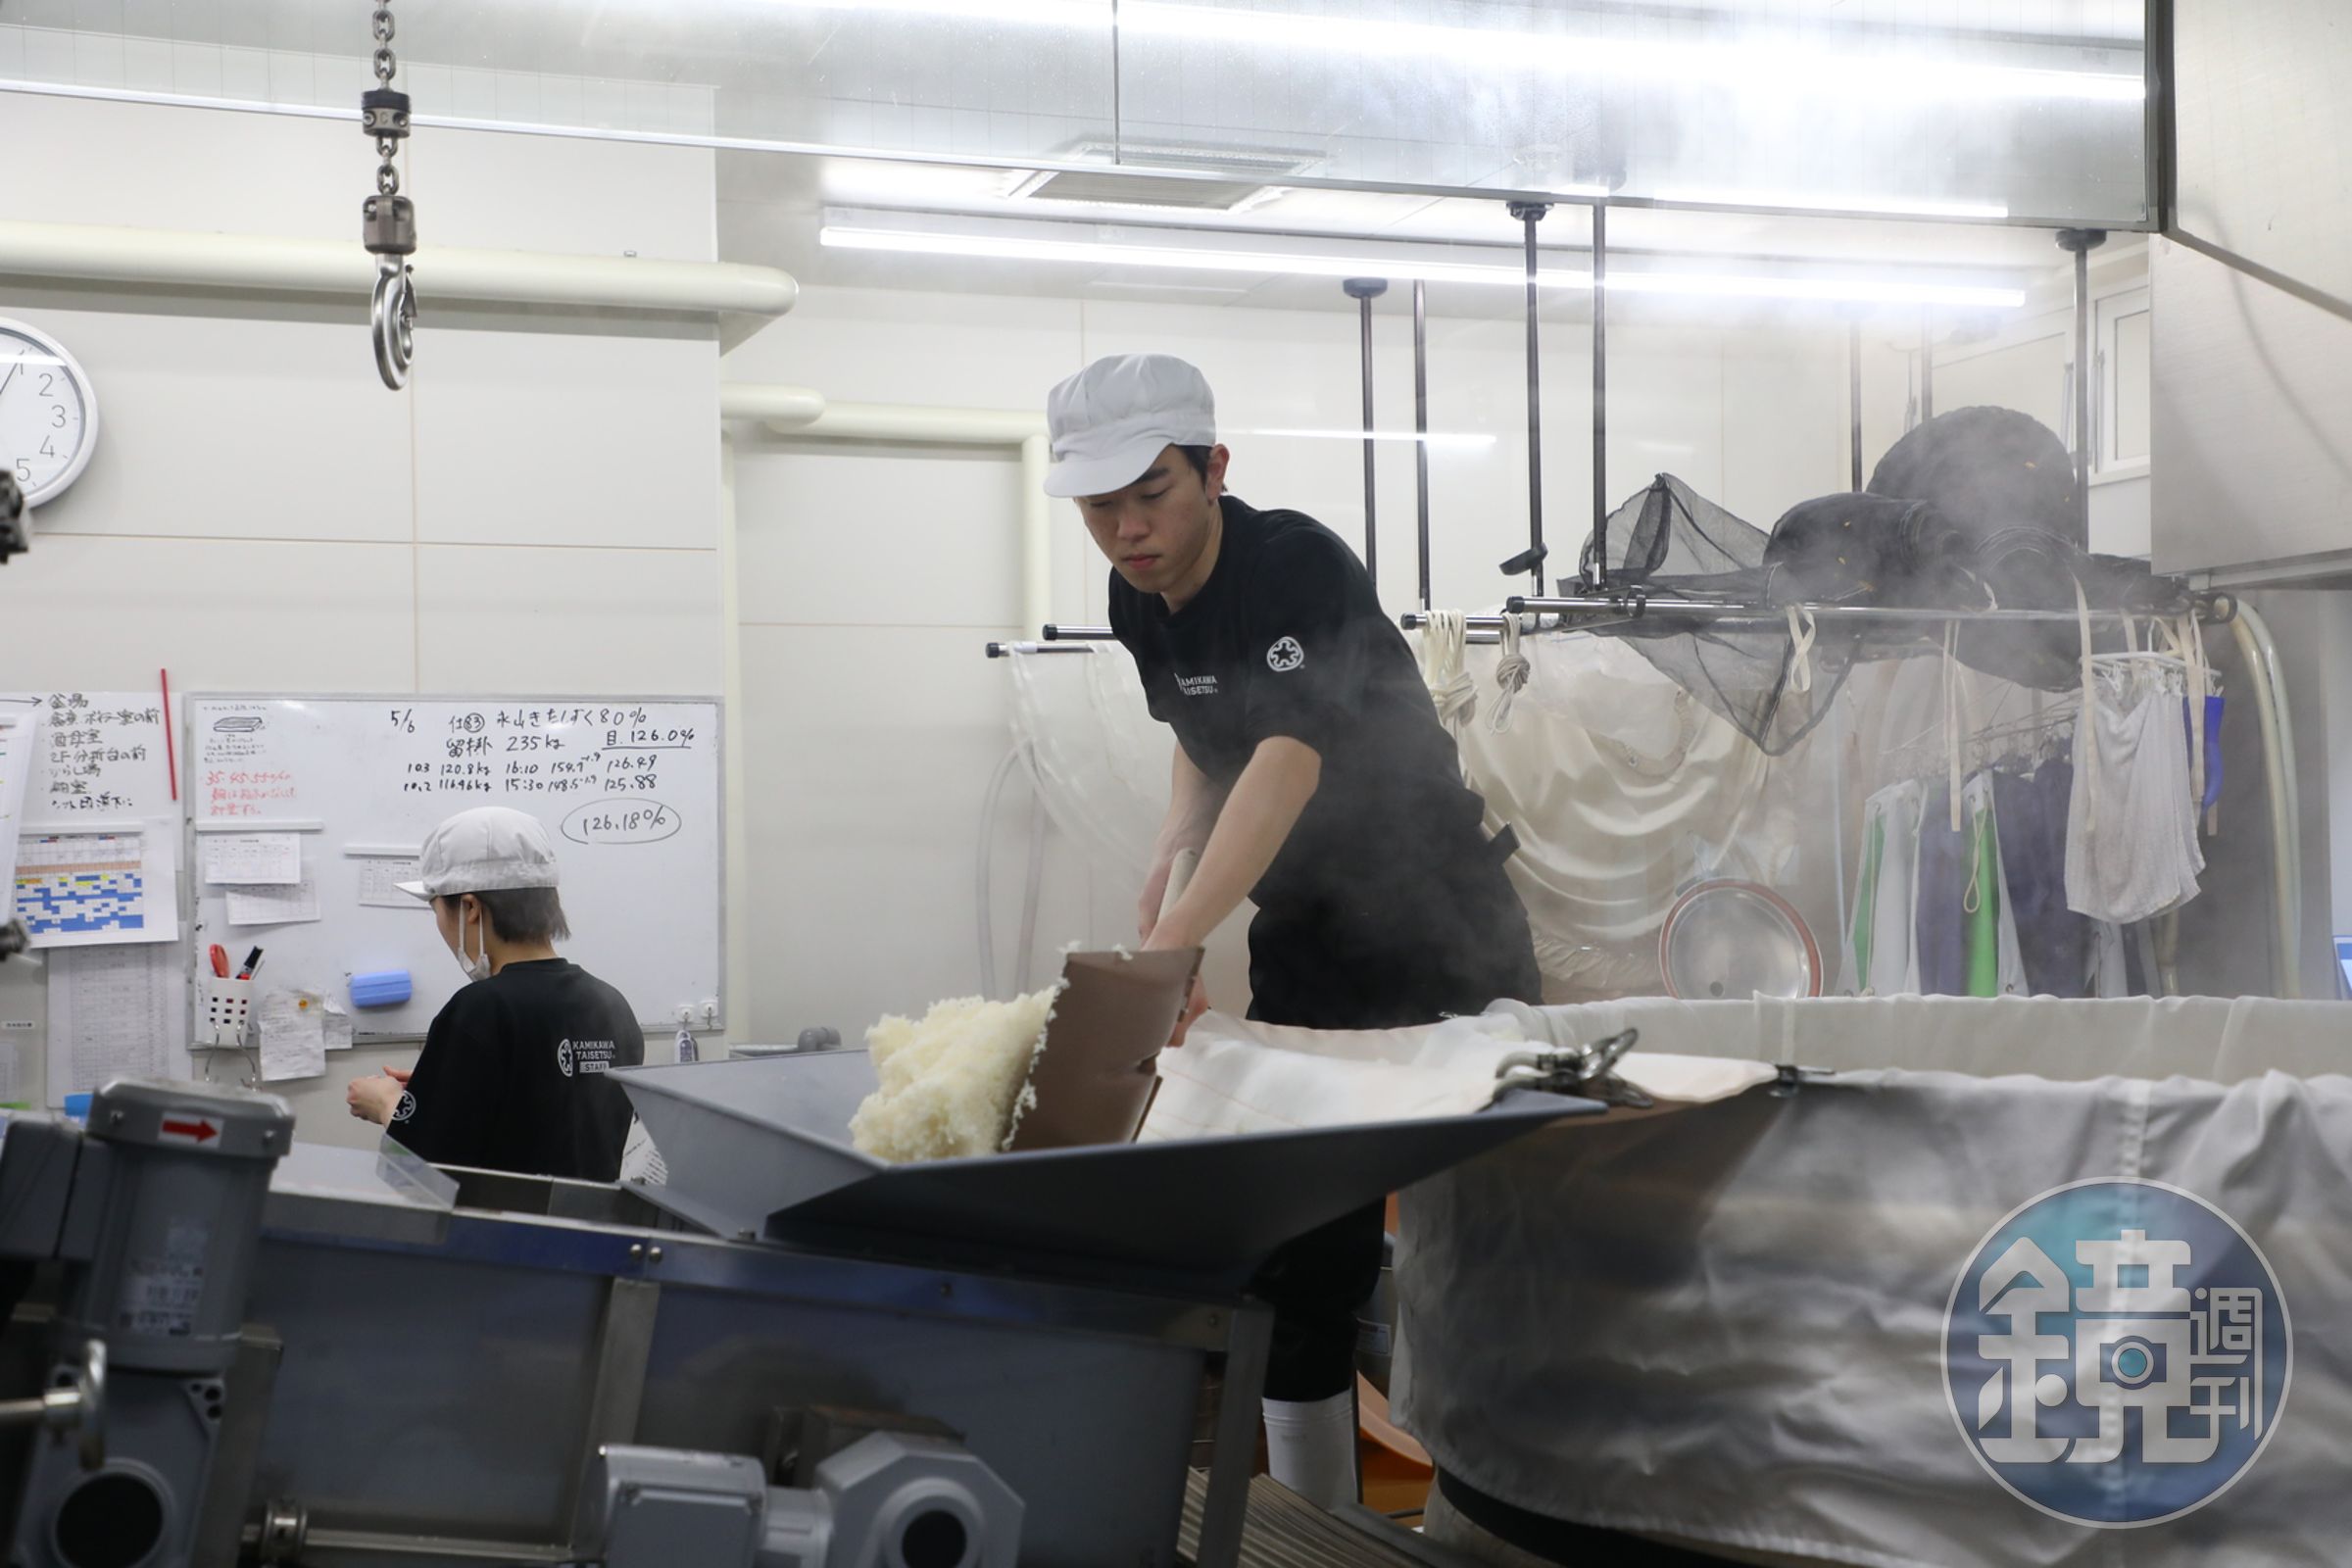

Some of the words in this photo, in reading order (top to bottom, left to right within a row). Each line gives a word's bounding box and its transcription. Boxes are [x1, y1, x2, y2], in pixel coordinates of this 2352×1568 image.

[38, 372, 54, 397] 2
[51, 404, 67, 428] 3
[39, 434, 56, 459] 4
[16, 458, 31, 482] 5
[390, 709, 416, 734] 5/6
[506, 760, 539, 774] 16:10
[505, 778, 544, 792] 15:30
[605, 773, 658, 792] 125.88
[583, 805, 666, 836] 126.18%
[572, 1041, 615, 1051] KAMIKAWA
[575, 1051, 612, 1060] TAISETSU
